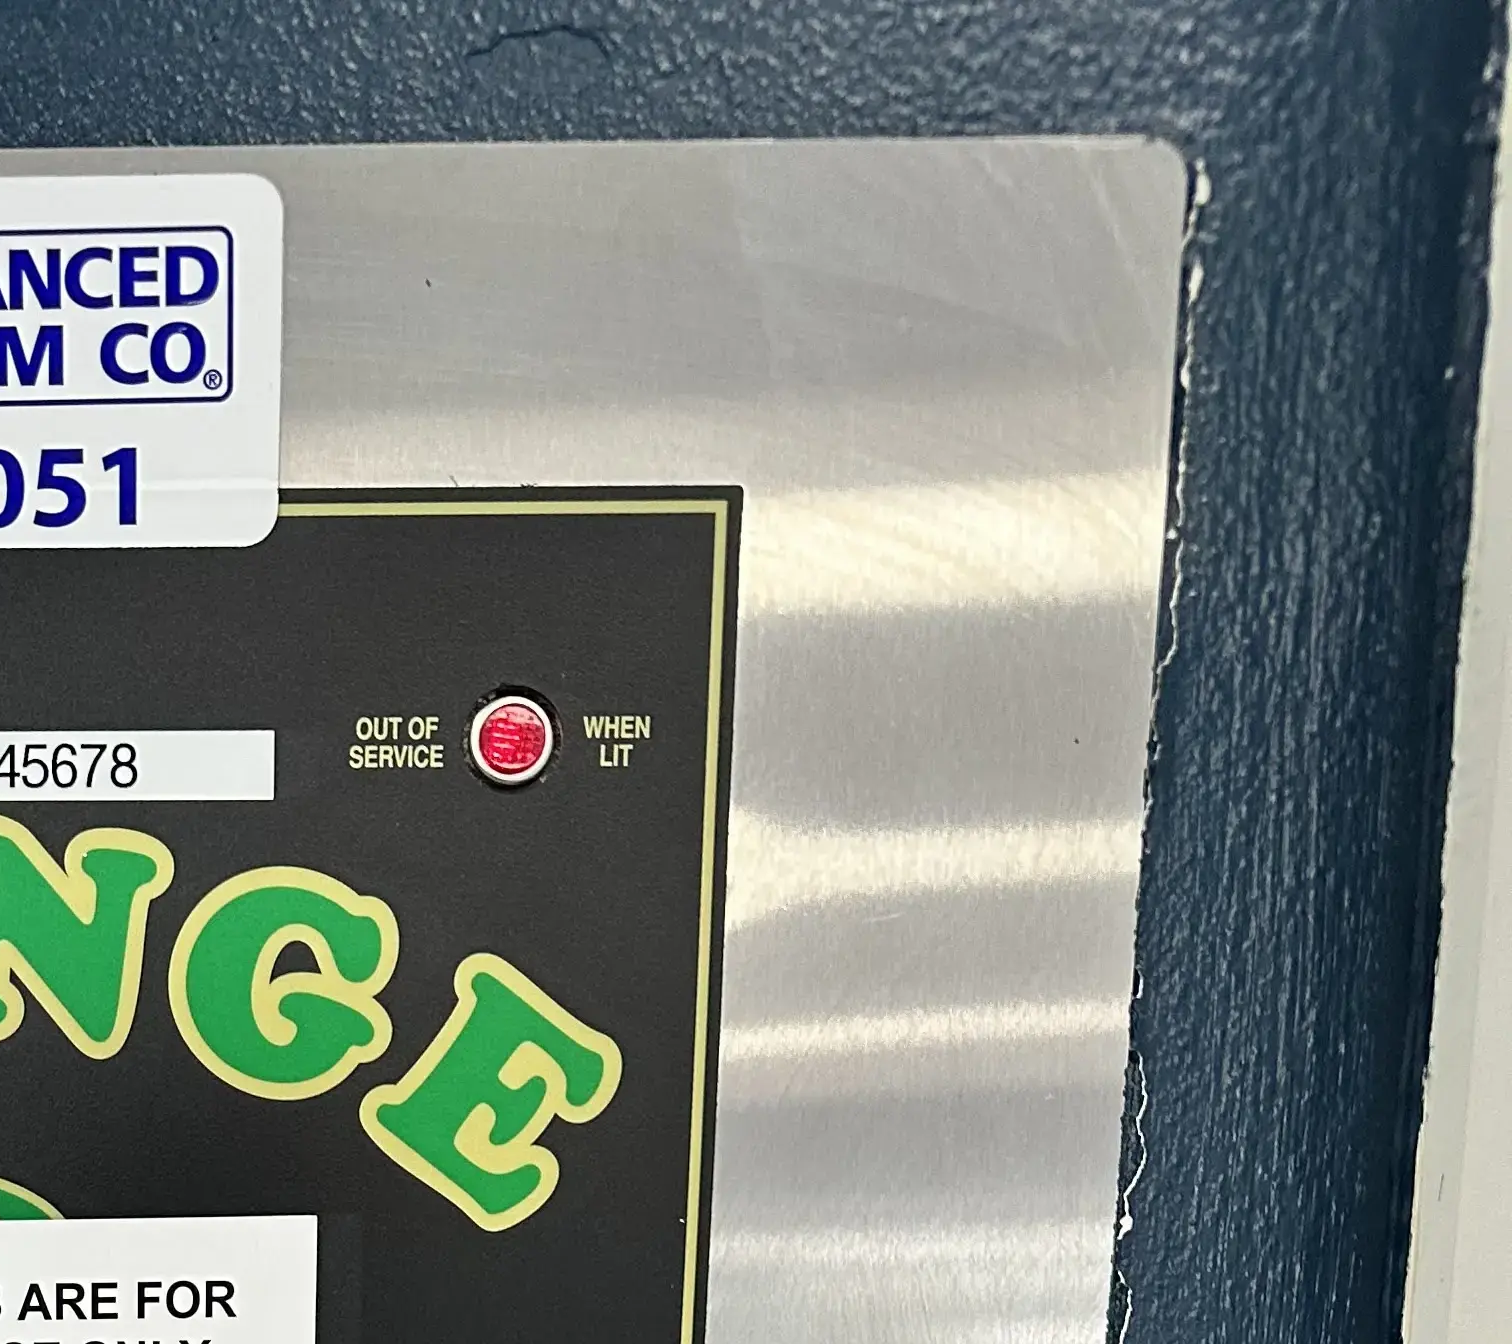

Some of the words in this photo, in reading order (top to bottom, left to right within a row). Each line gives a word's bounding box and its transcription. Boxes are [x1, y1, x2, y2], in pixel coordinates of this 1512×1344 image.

[355, 716, 403, 741] OUT
[407, 716, 440, 741] OF
[582, 715, 651, 739] WHEN
[348, 744, 444, 769] SERVICE
[599, 743, 634, 767] LIT
[17, 1281, 119, 1321] ARE
[137, 1280, 237, 1320] FOR
